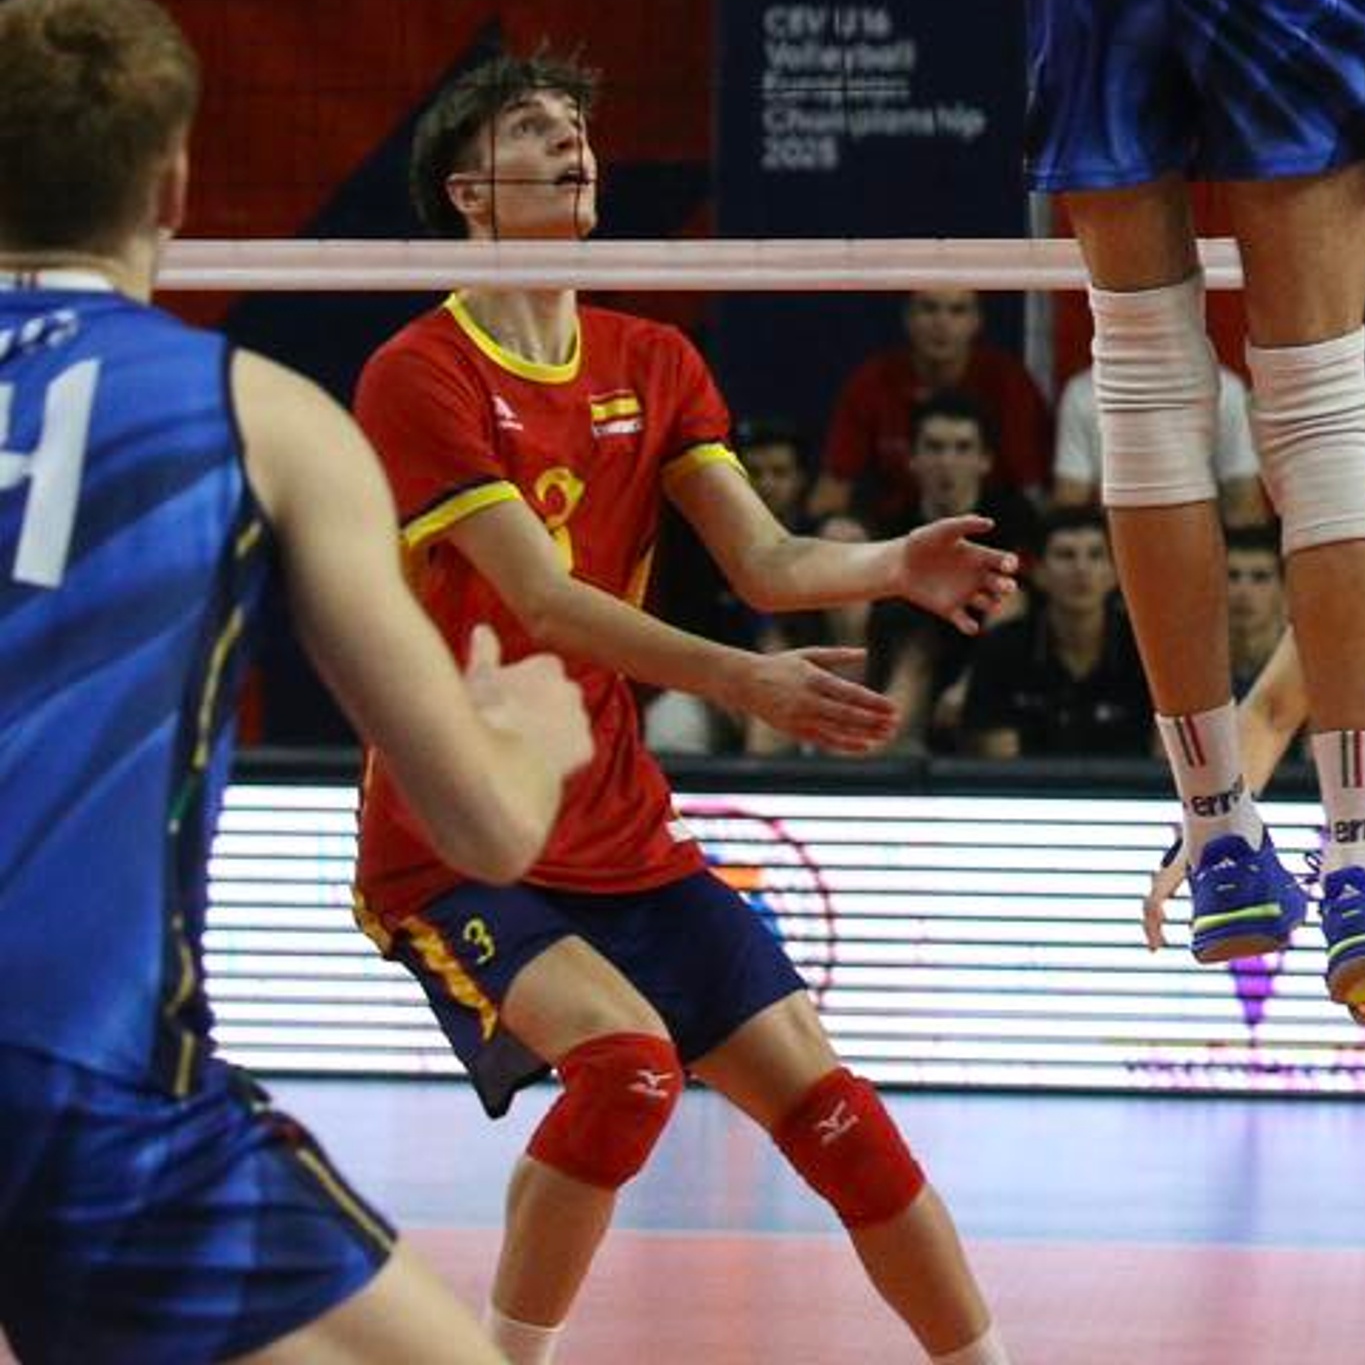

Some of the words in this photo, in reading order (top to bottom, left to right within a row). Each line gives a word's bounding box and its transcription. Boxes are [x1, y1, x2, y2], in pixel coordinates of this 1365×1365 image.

[764, 7, 827, 36] CEV
[762, 137, 838, 169] 2025
[462, 917, 498, 965] 3
